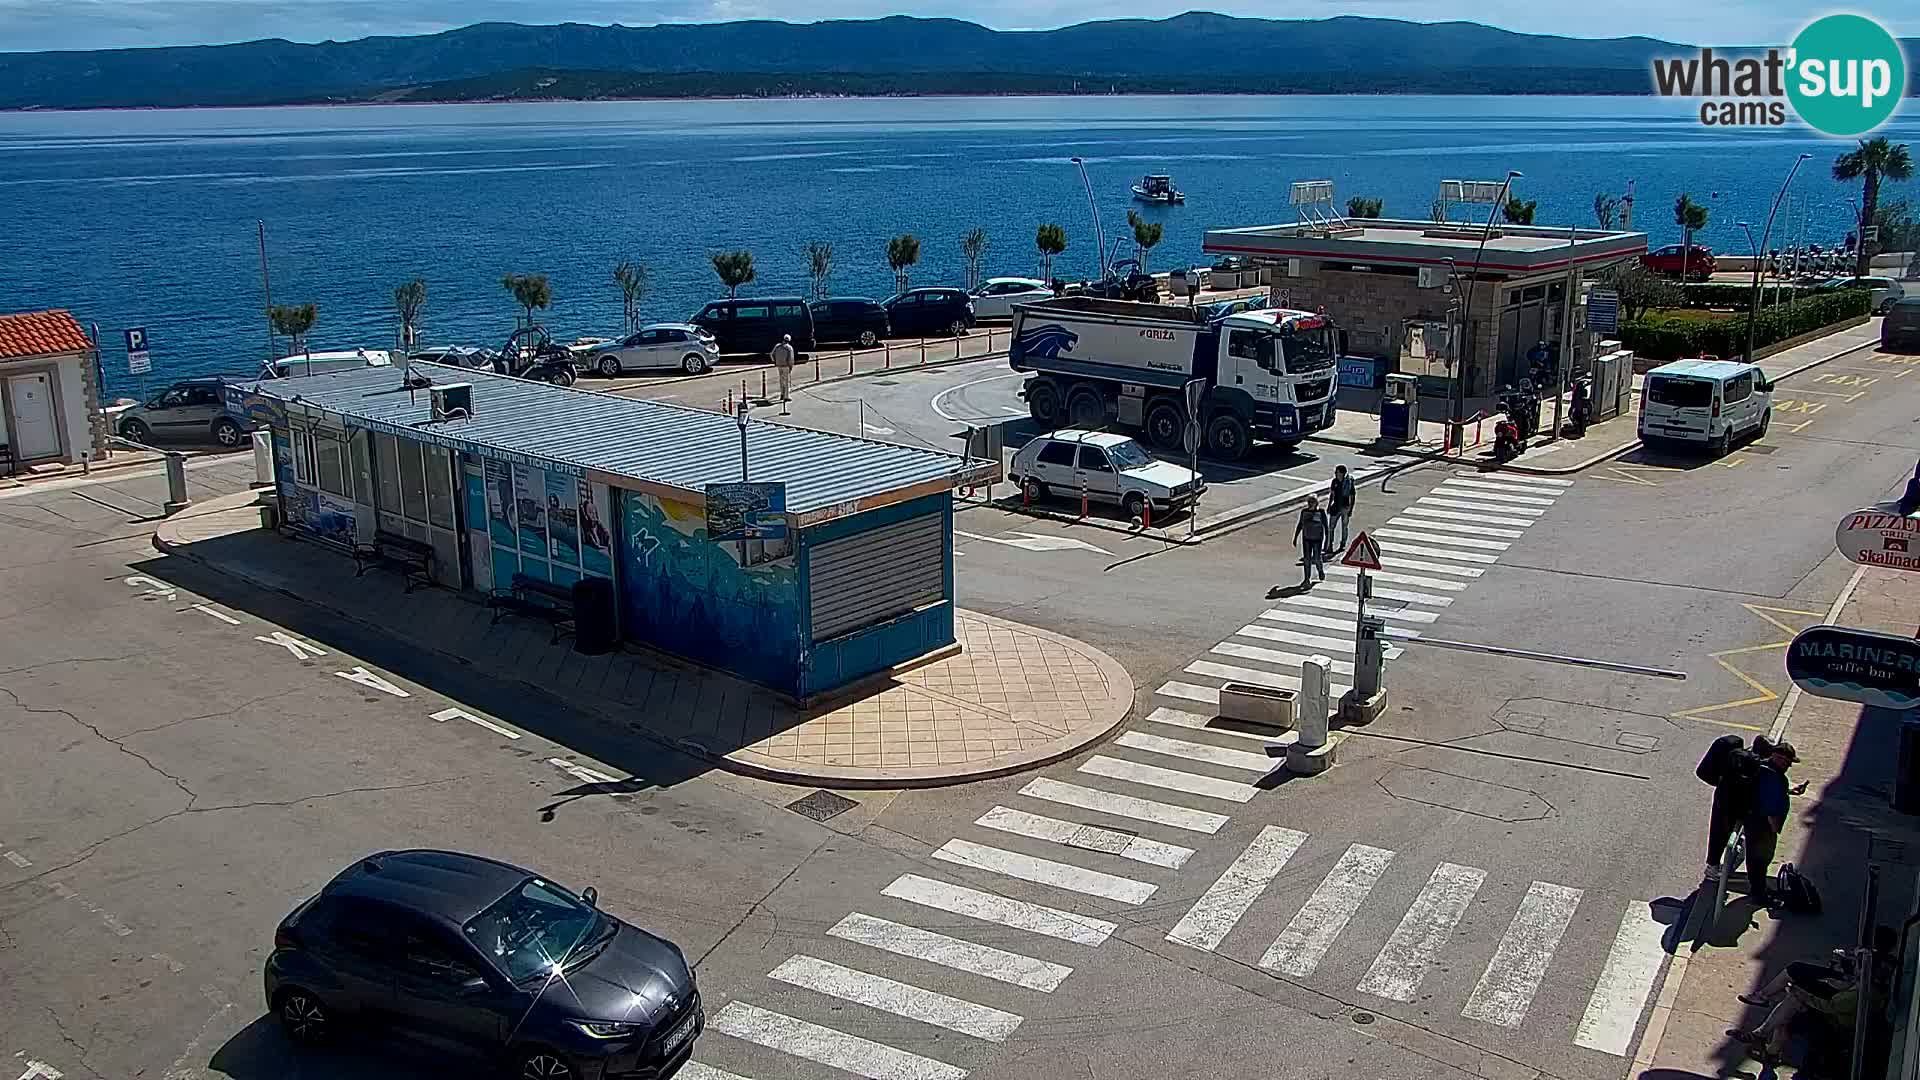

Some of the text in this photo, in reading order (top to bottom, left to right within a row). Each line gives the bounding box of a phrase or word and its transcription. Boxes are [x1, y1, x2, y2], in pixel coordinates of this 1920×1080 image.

[130, 331, 142, 349] P
[494, 449, 526, 464] STATION
[529, 457, 553, 470] TICKET
[555, 463, 582, 476] OFFICE
[1828, 661, 1895, 679] caffe bar
